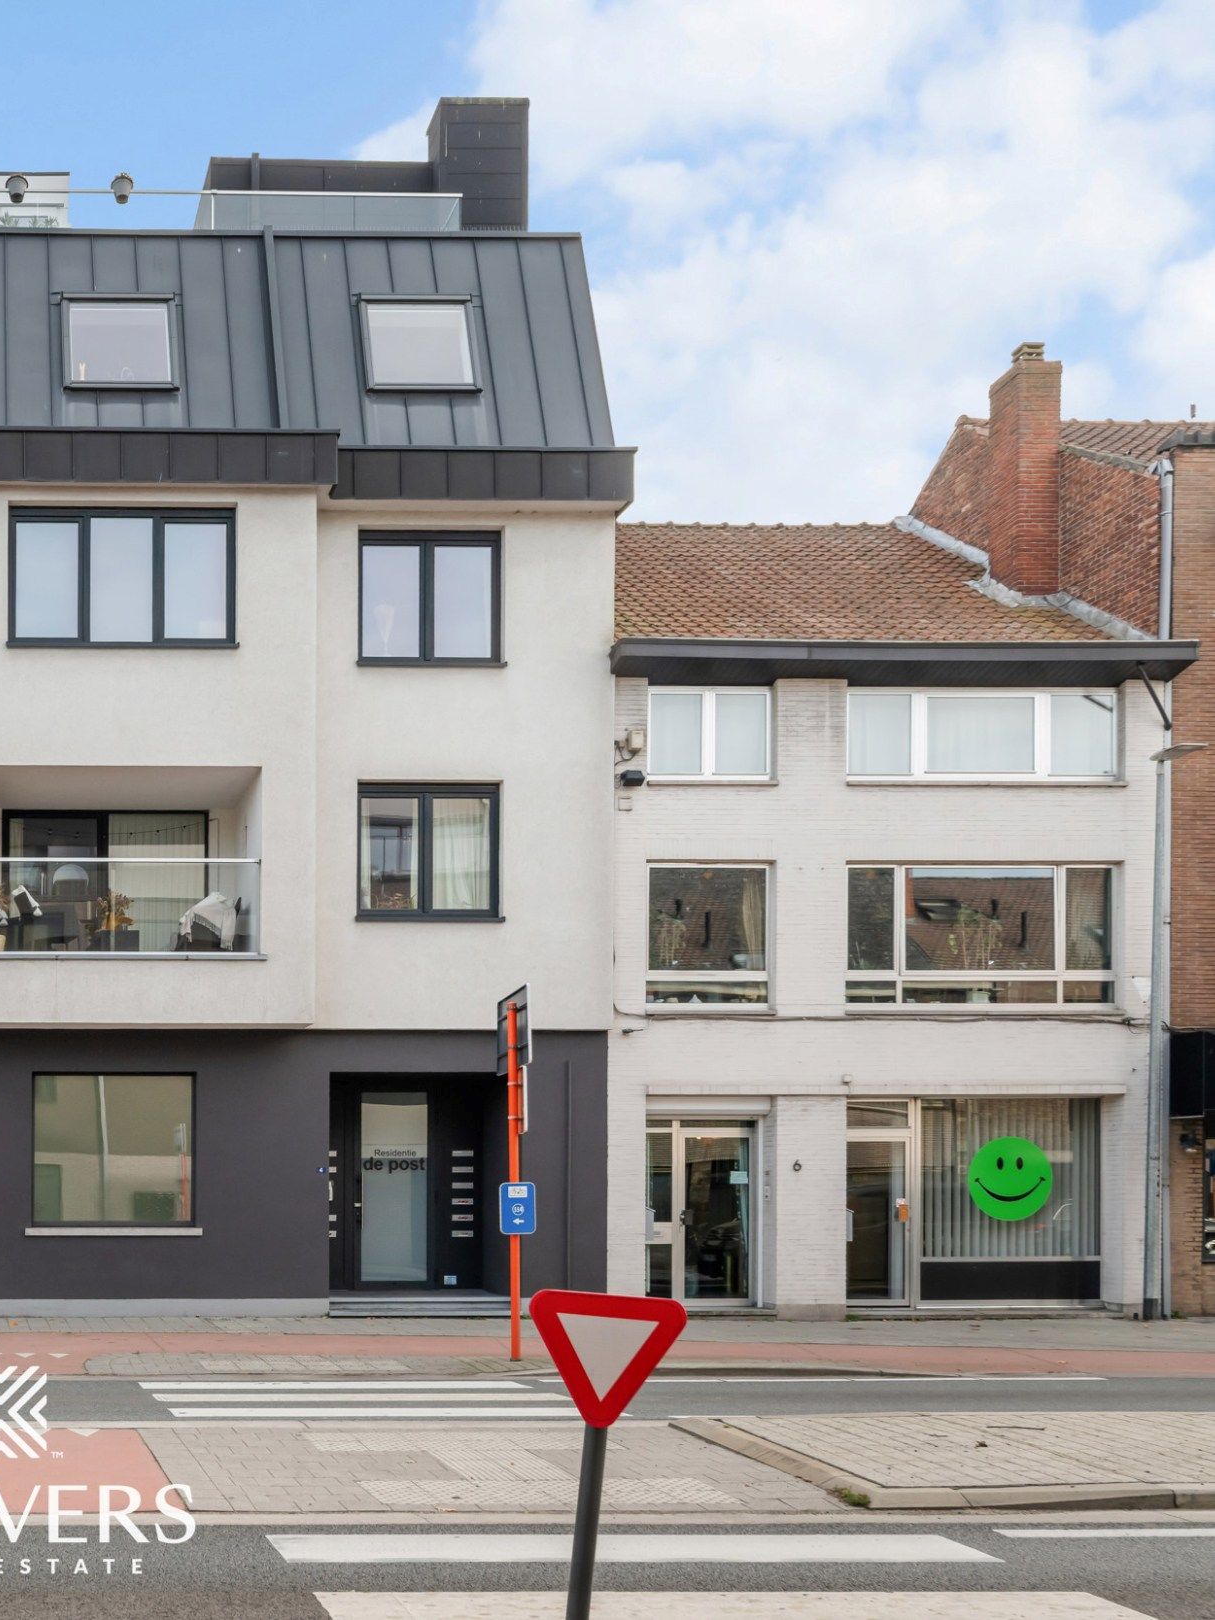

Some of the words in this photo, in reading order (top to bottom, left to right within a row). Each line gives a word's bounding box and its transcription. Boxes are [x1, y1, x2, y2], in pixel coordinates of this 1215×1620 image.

[374, 1149, 417, 1157] Residentie
[363, 1156, 383, 1171] de
[388, 1157, 426, 1174] post
[793, 1159, 802, 1172] 6
